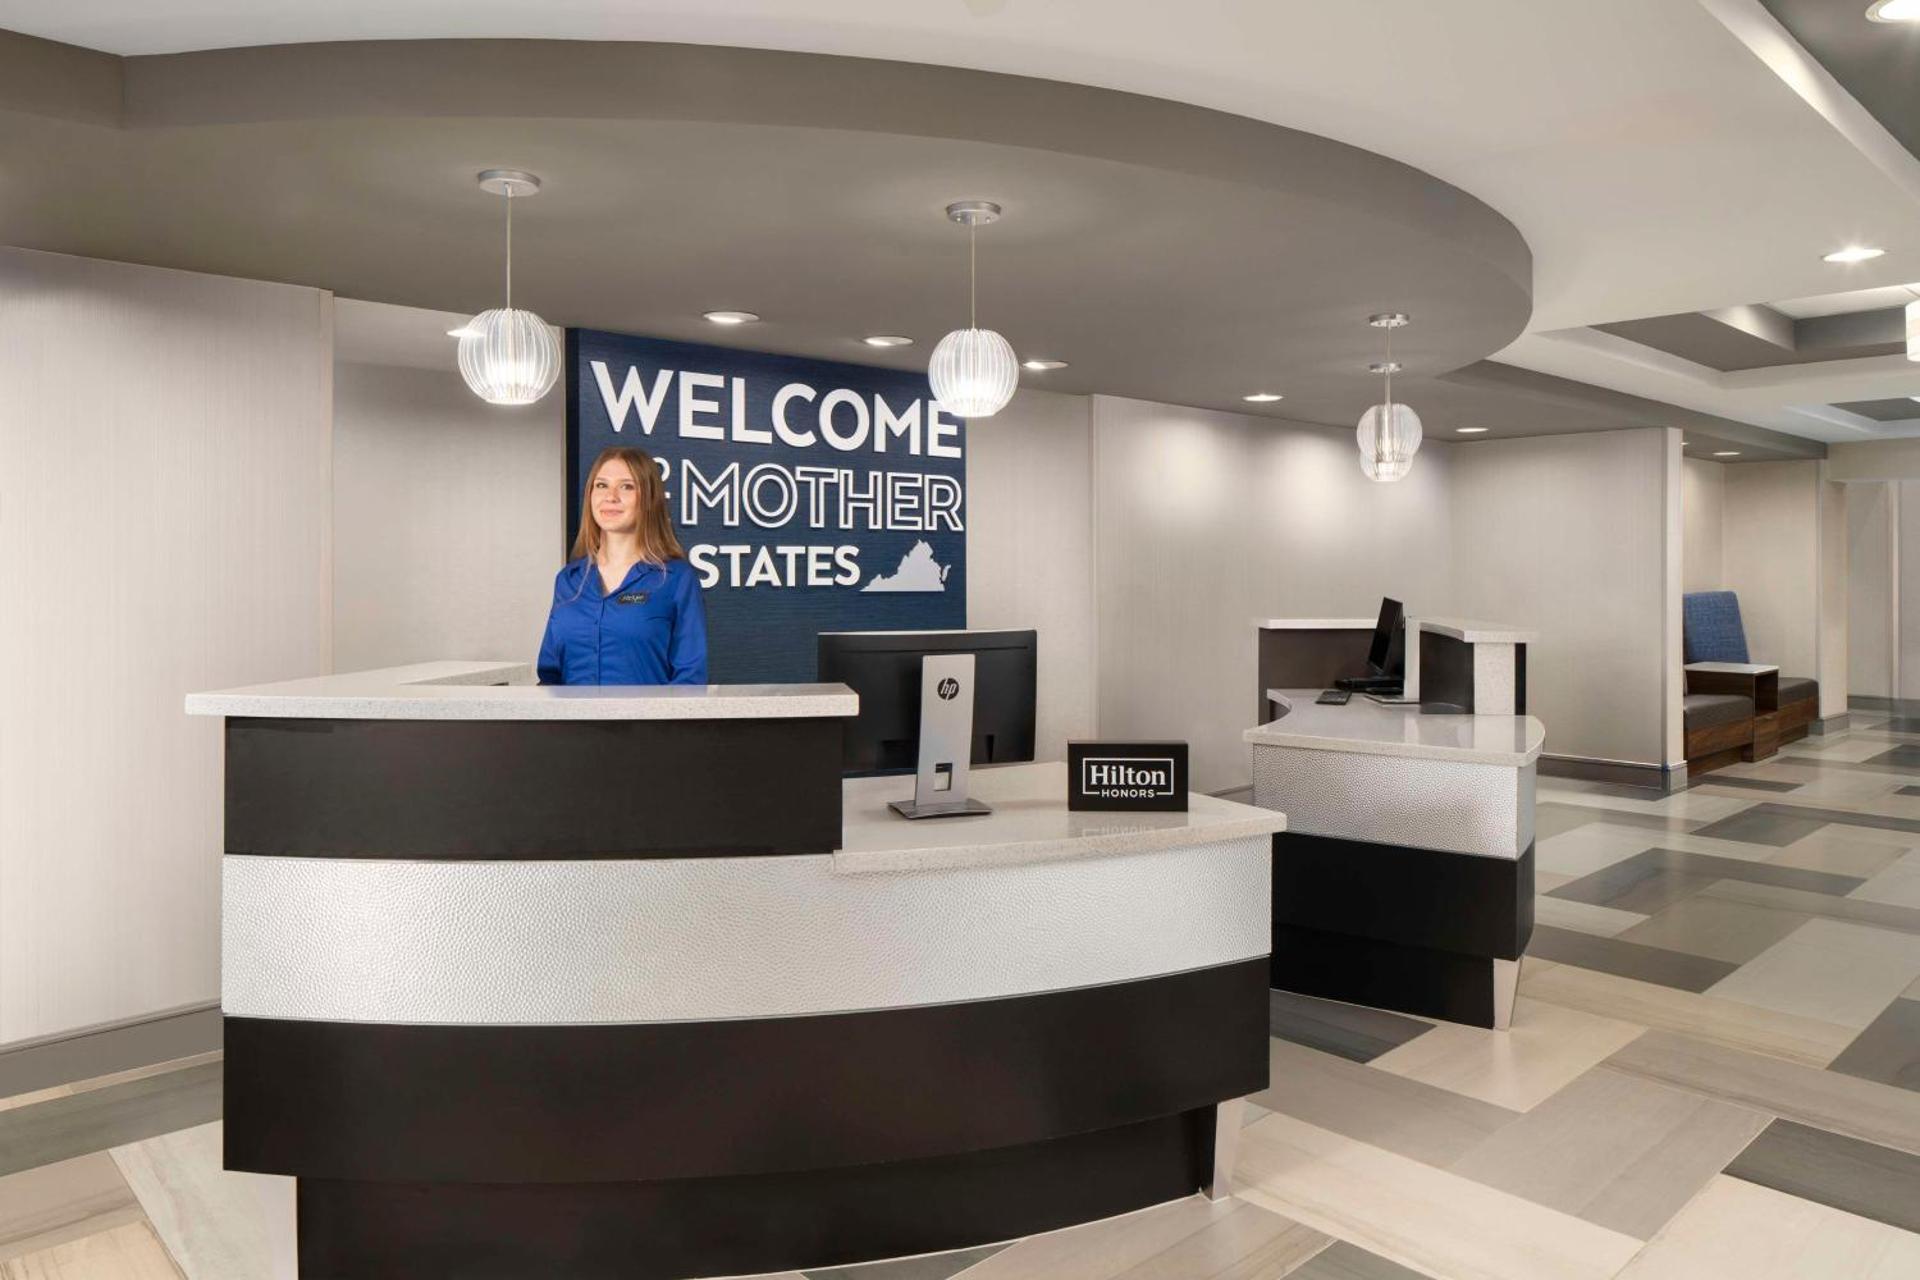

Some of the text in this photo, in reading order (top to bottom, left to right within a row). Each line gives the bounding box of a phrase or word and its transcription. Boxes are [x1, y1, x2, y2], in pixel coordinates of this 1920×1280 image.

[590, 360, 962, 458] WELCOME
[681, 458, 964, 531] MOTHER
[688, 543, 861, 588] STATES
[938, 679, 958, 701] hp
[1090, 765, 1166, 786] Hilton
[1101, 789, 1155, 798] HONORS
